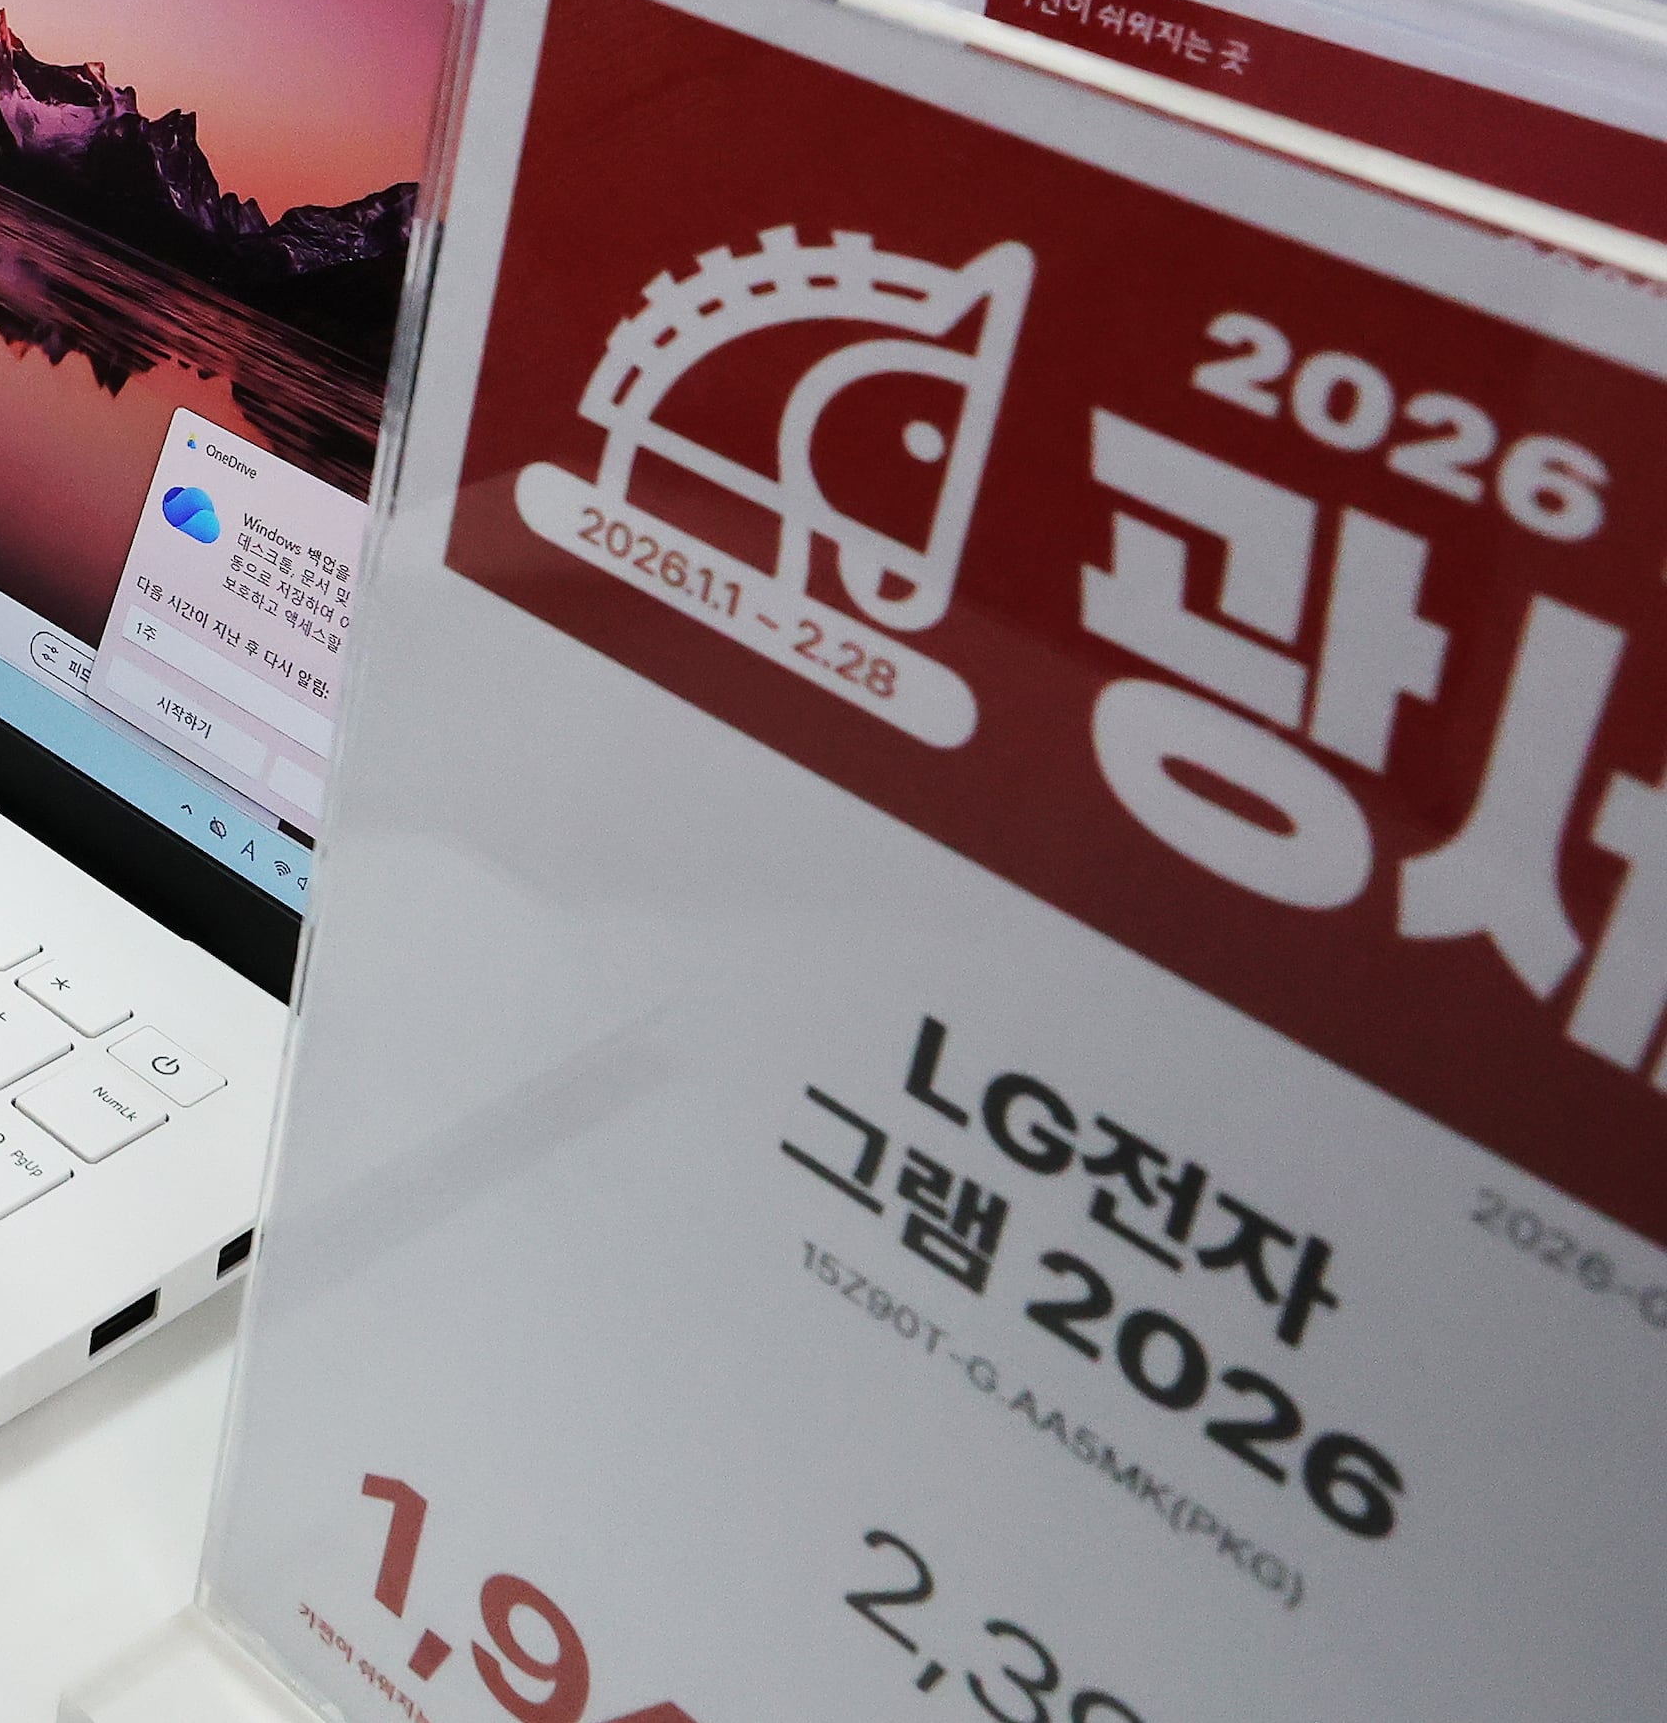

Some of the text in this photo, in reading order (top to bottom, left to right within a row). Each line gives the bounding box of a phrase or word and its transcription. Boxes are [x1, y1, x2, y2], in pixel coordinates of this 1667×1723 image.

[1098, 1, 1214, 63] 쉬워지는
[1219, 40, 1253, 77] 곳
[1190, 309, 1611, 545] 2026
[205, 443, 258, 480] OneDrive
[243, 512, 303, 556] Windows
[222, 575, 279, 618] 보호하고
[229, 554, 273, 588] 동으로
[275, 580, 335, 624] 저장하여
[300, 569, 331, 596] 문서
[575, 504, 899, 702] 2026.1.1 2.28
[136, 575, 164, 603] 다음
[166, 594, 210, 630] 시간이
[212, 619, 242, 648] 지난
[243, 637, 260, 658] 후
[263, 649, 294, 679] 다시
[136, 621, 158, 643] 1주
[156, 695, 213, 740] 시작하기
[91, 1085, 139, 1124] NumLk
[8, 1148, 45, 1179] PgUp
[903, 1014, 1340, 1349] LG전자
[778, 1082, 1407, 1541] 그램 2026
[360, 1472, 699, 1723] 1,9
